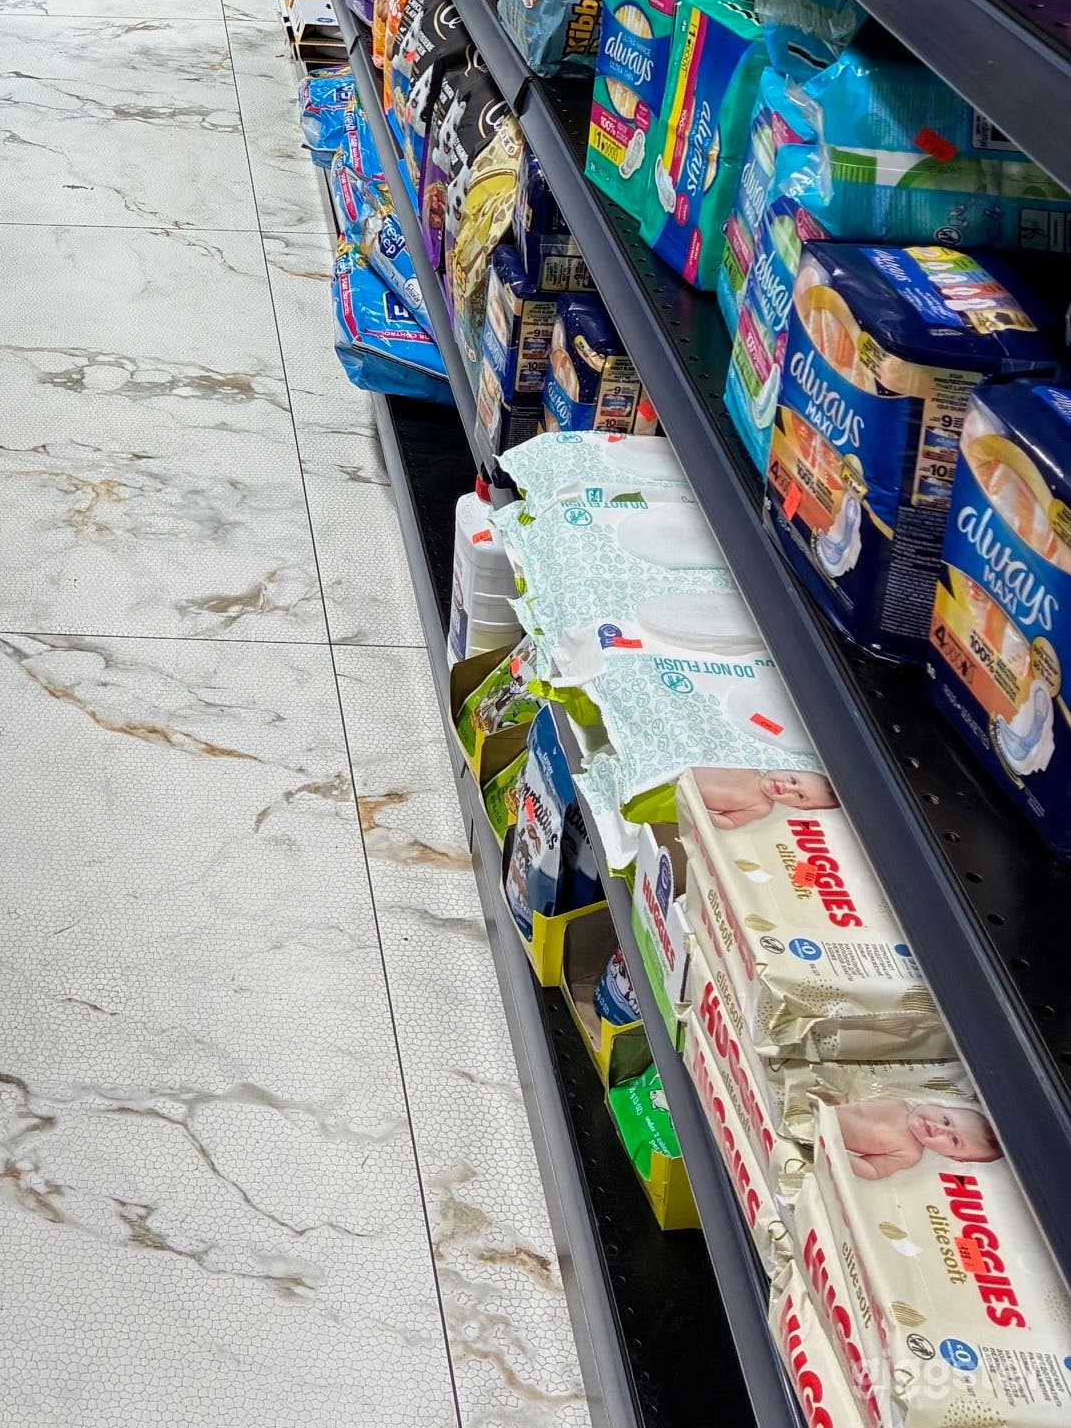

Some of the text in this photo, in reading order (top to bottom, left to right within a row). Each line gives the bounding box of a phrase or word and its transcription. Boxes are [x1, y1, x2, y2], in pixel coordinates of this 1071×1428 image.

[605, 32, 654, 86] always
[686, 100, 713, 198] always
[873, 249, 913, 284] always
[528, 362, 539, 371] 10
[789, 348, 866, 450] always
[941, 414, 953, 429] 9
[605, 418, 617, 427] 10
[804, 400, 836, 445] MAXI
[769, 461, 780, 483] 4
[930, 464, 948, 478] 10
[955, 504, 1060, 632] always
[983, 565, 1017, 616] MAXI
[936, 624, 947, 650] 4
[970, 635, 995, 669] 100%
[654, 657, 755, 678] DO NOT FLUSH
[775, 842, 797, 873] elite
[788, 819, 863, 928] HUGGIES
[642, 873, 676, 972] HUGGIES
[926, 1203, 965, 1286] elite soft
[939, 1172, 1027, 1330] HUGGIES
[841, 1240, 873, 1329] elite soft
